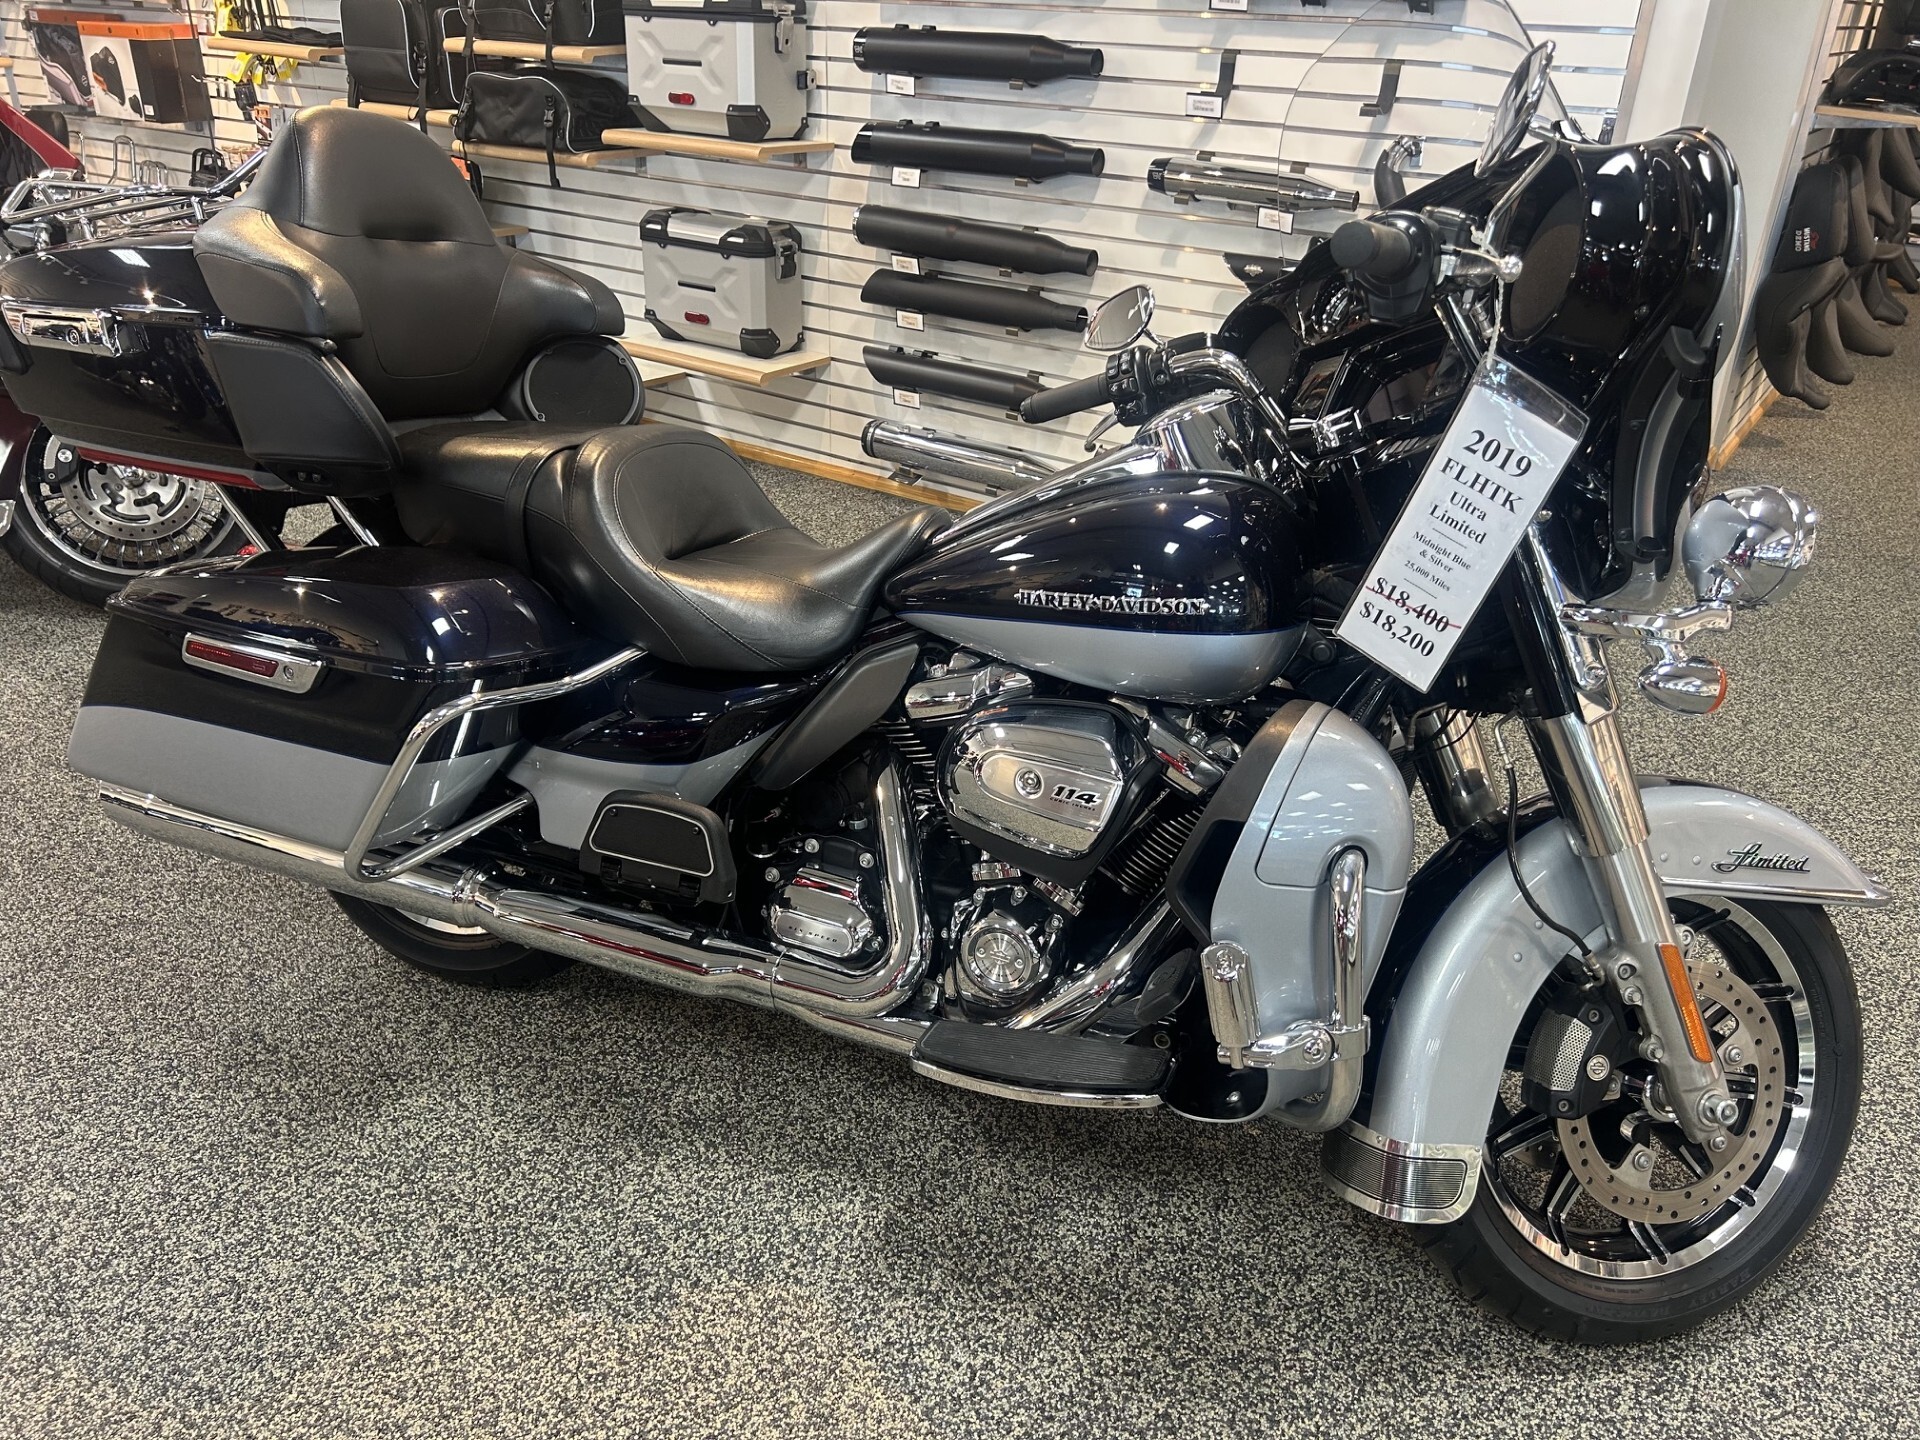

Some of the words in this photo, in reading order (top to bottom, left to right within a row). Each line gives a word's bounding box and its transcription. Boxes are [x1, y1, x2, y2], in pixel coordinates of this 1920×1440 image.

[1803, 227, 1811, 252] MUSTANG
[1462, 429, 1532, 477] 2019
[1439, 456, 1524, 515] FLHTK
[1449, 491, 1487, 521] Ultra
[1428, 504, 1487, 545] Limited
[1412, 531, 1452, 559] Midnight
[1452, 554, 1472, 570] Blue
[1419, 549, 1428, 559] &
[1428, 554, 1454, 573] Silver
[1404, 560, 1430, 579] 25,000
[1429, 574, 1451, 592] Miles
[1372, 577, 1450, 633] $18,400
[1359, 601, 1435, 657] $18,200
[1051, 784, 1103, 806] 114
[1711, 841, 1811, 874] Limited
